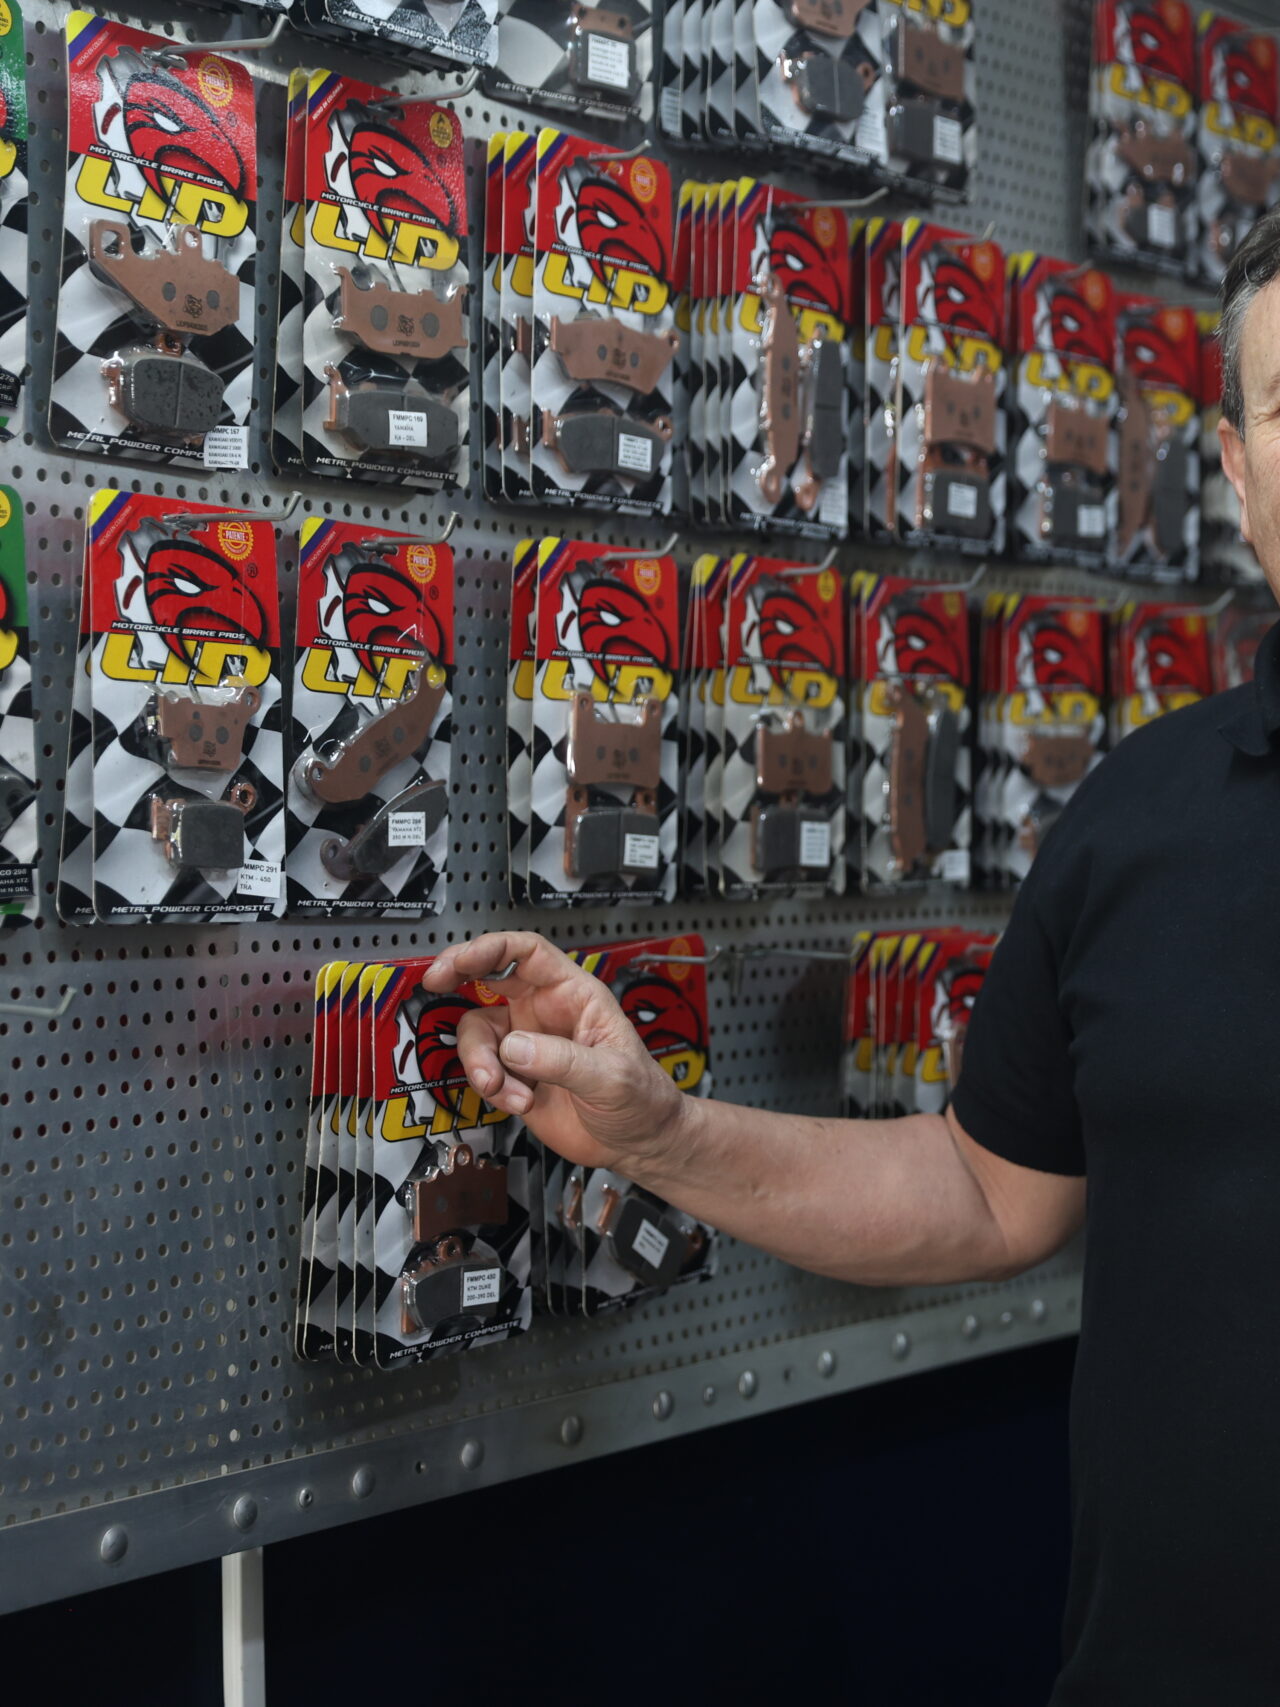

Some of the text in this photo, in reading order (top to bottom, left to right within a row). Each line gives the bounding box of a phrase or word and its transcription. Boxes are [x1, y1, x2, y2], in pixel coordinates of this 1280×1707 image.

[343, 8, 376, 24] METAL
[380, 20, 423, 40] POWDER
[496, 82, 529, 94] METAL
[532, 88, 576, 104] POWDER
[90, 145, 224, 188] MOTORCYCLE BRAKE PADS
[76, 155, 249, 238] LID
[322, 192, 436, 224] MOTORCYCLE BRAKE PADS
[310, 201, 460, 271] LID
[542, 252, 669, 316] LID
[66, 430, 204, 460] METAL POWDER COMPO
[316, 457, 456, 480] METAL POWDER COMPOSITE
[225, 530, 246, 542] PATENTE
[112, 621, 246, 640] MOTORCYCLE BRAKE PADS
[100, 632, 272, 688] LID
[314, 637, 426, 658] MOTORCYCLE BRAKE PADS
[244, 863, 264, 872] MMPC
[112, 904, 272, 913] METAL POWDER COMPOSITE
[297, 900, 434, 909] METAL POWDER COMPOSITE
[390, 1079, 445, 1094] MOTORCYCLE
[390, 1320, 520, 1359] METAL POWDER COMPOSITE
